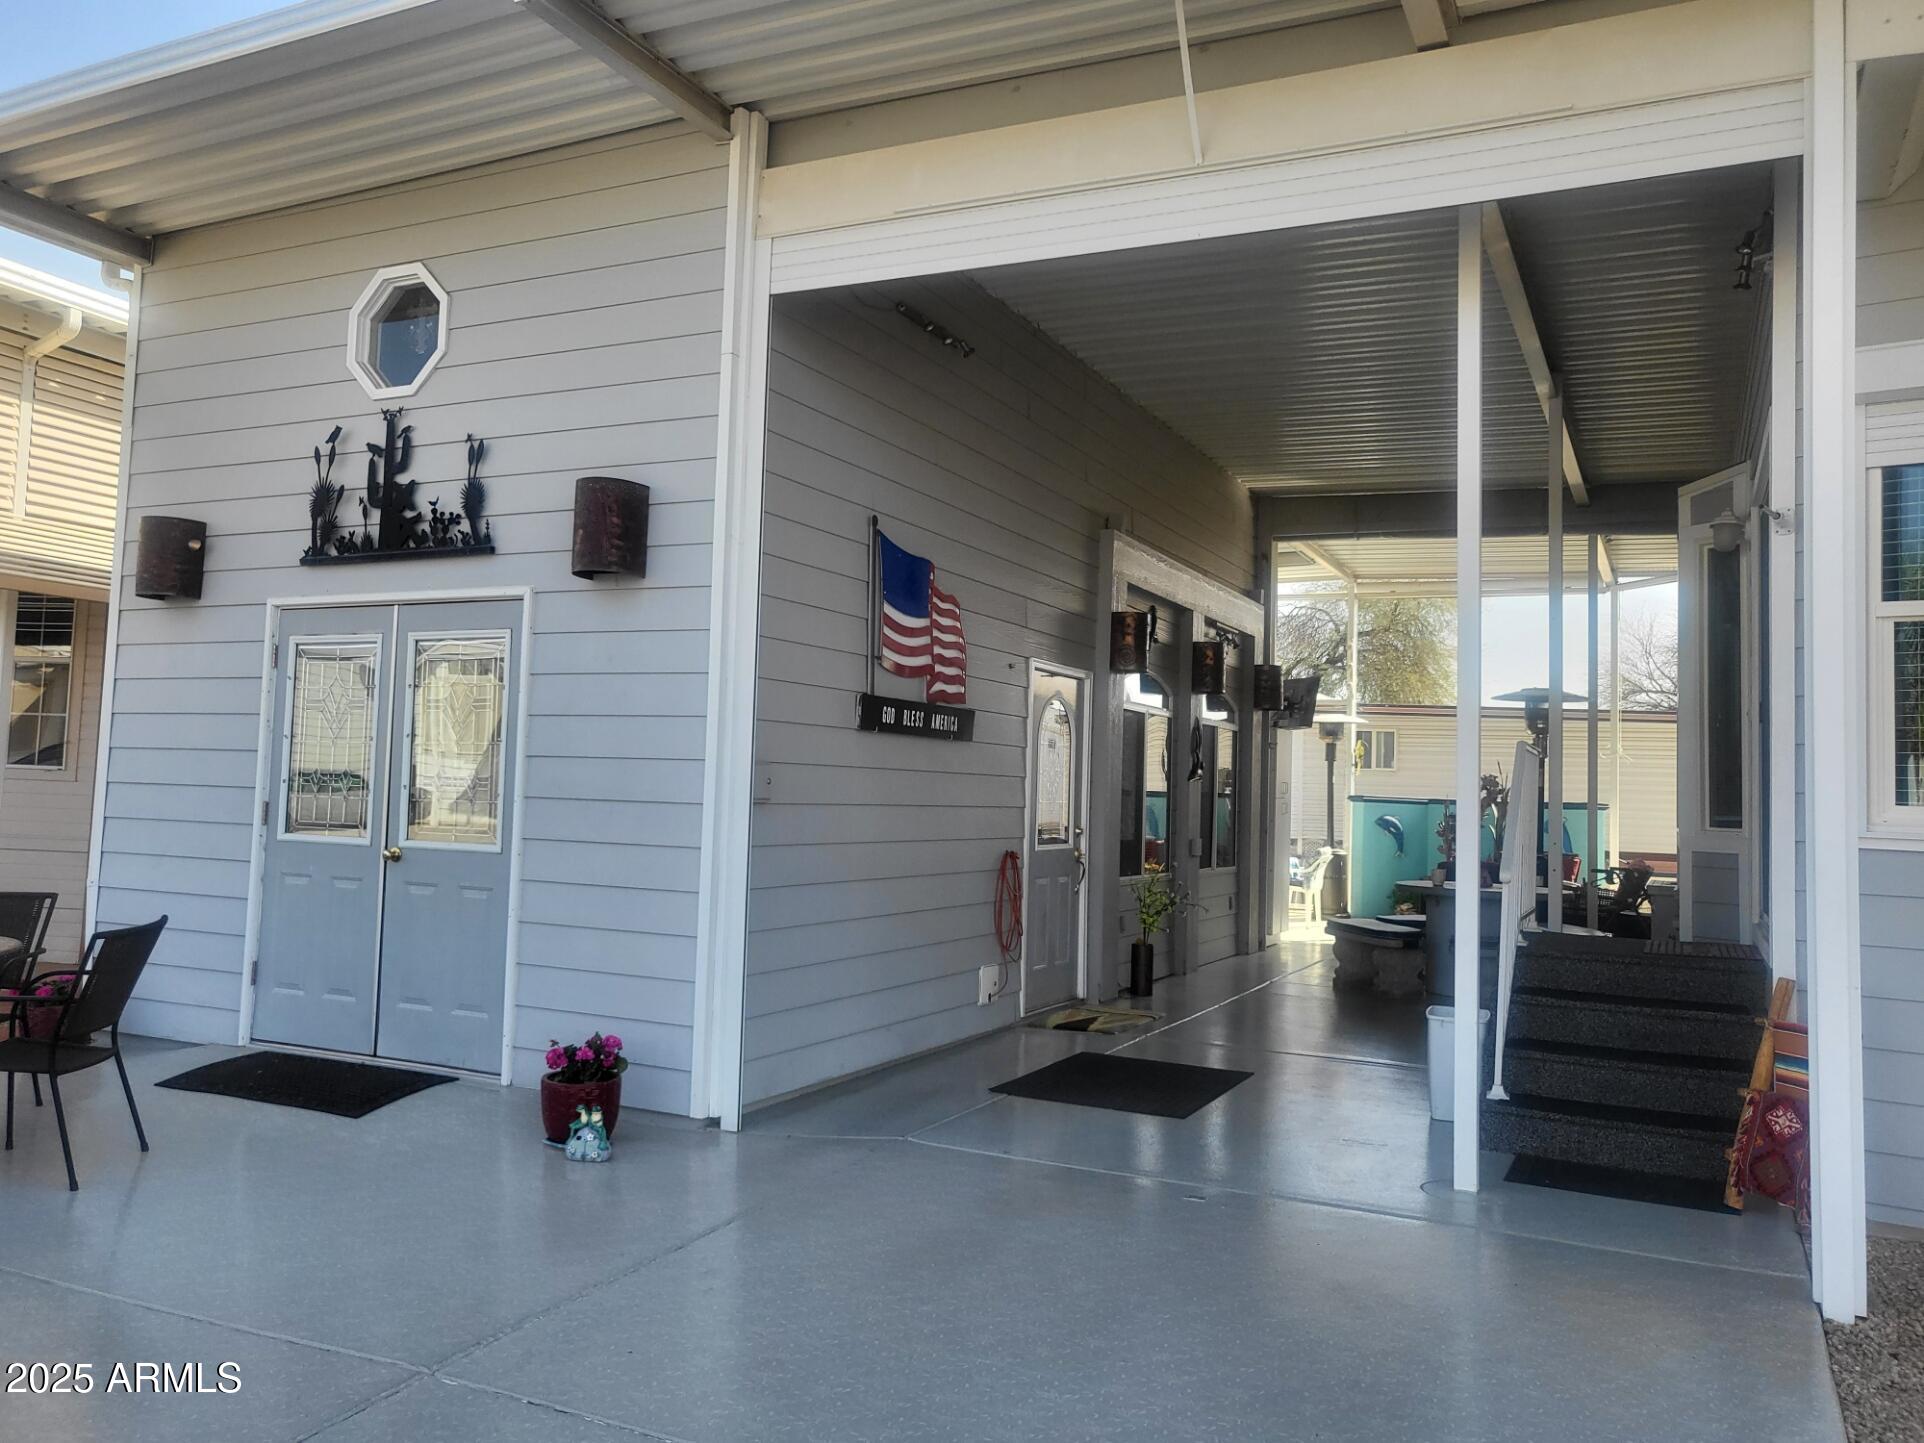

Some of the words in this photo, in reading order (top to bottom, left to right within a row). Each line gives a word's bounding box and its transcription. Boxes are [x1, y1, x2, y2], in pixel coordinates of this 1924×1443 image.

[882, 706, 896, 724] GOD
[903, 709, 925, 728] BLESS
[930, 713, 958, 732] AMERICA
